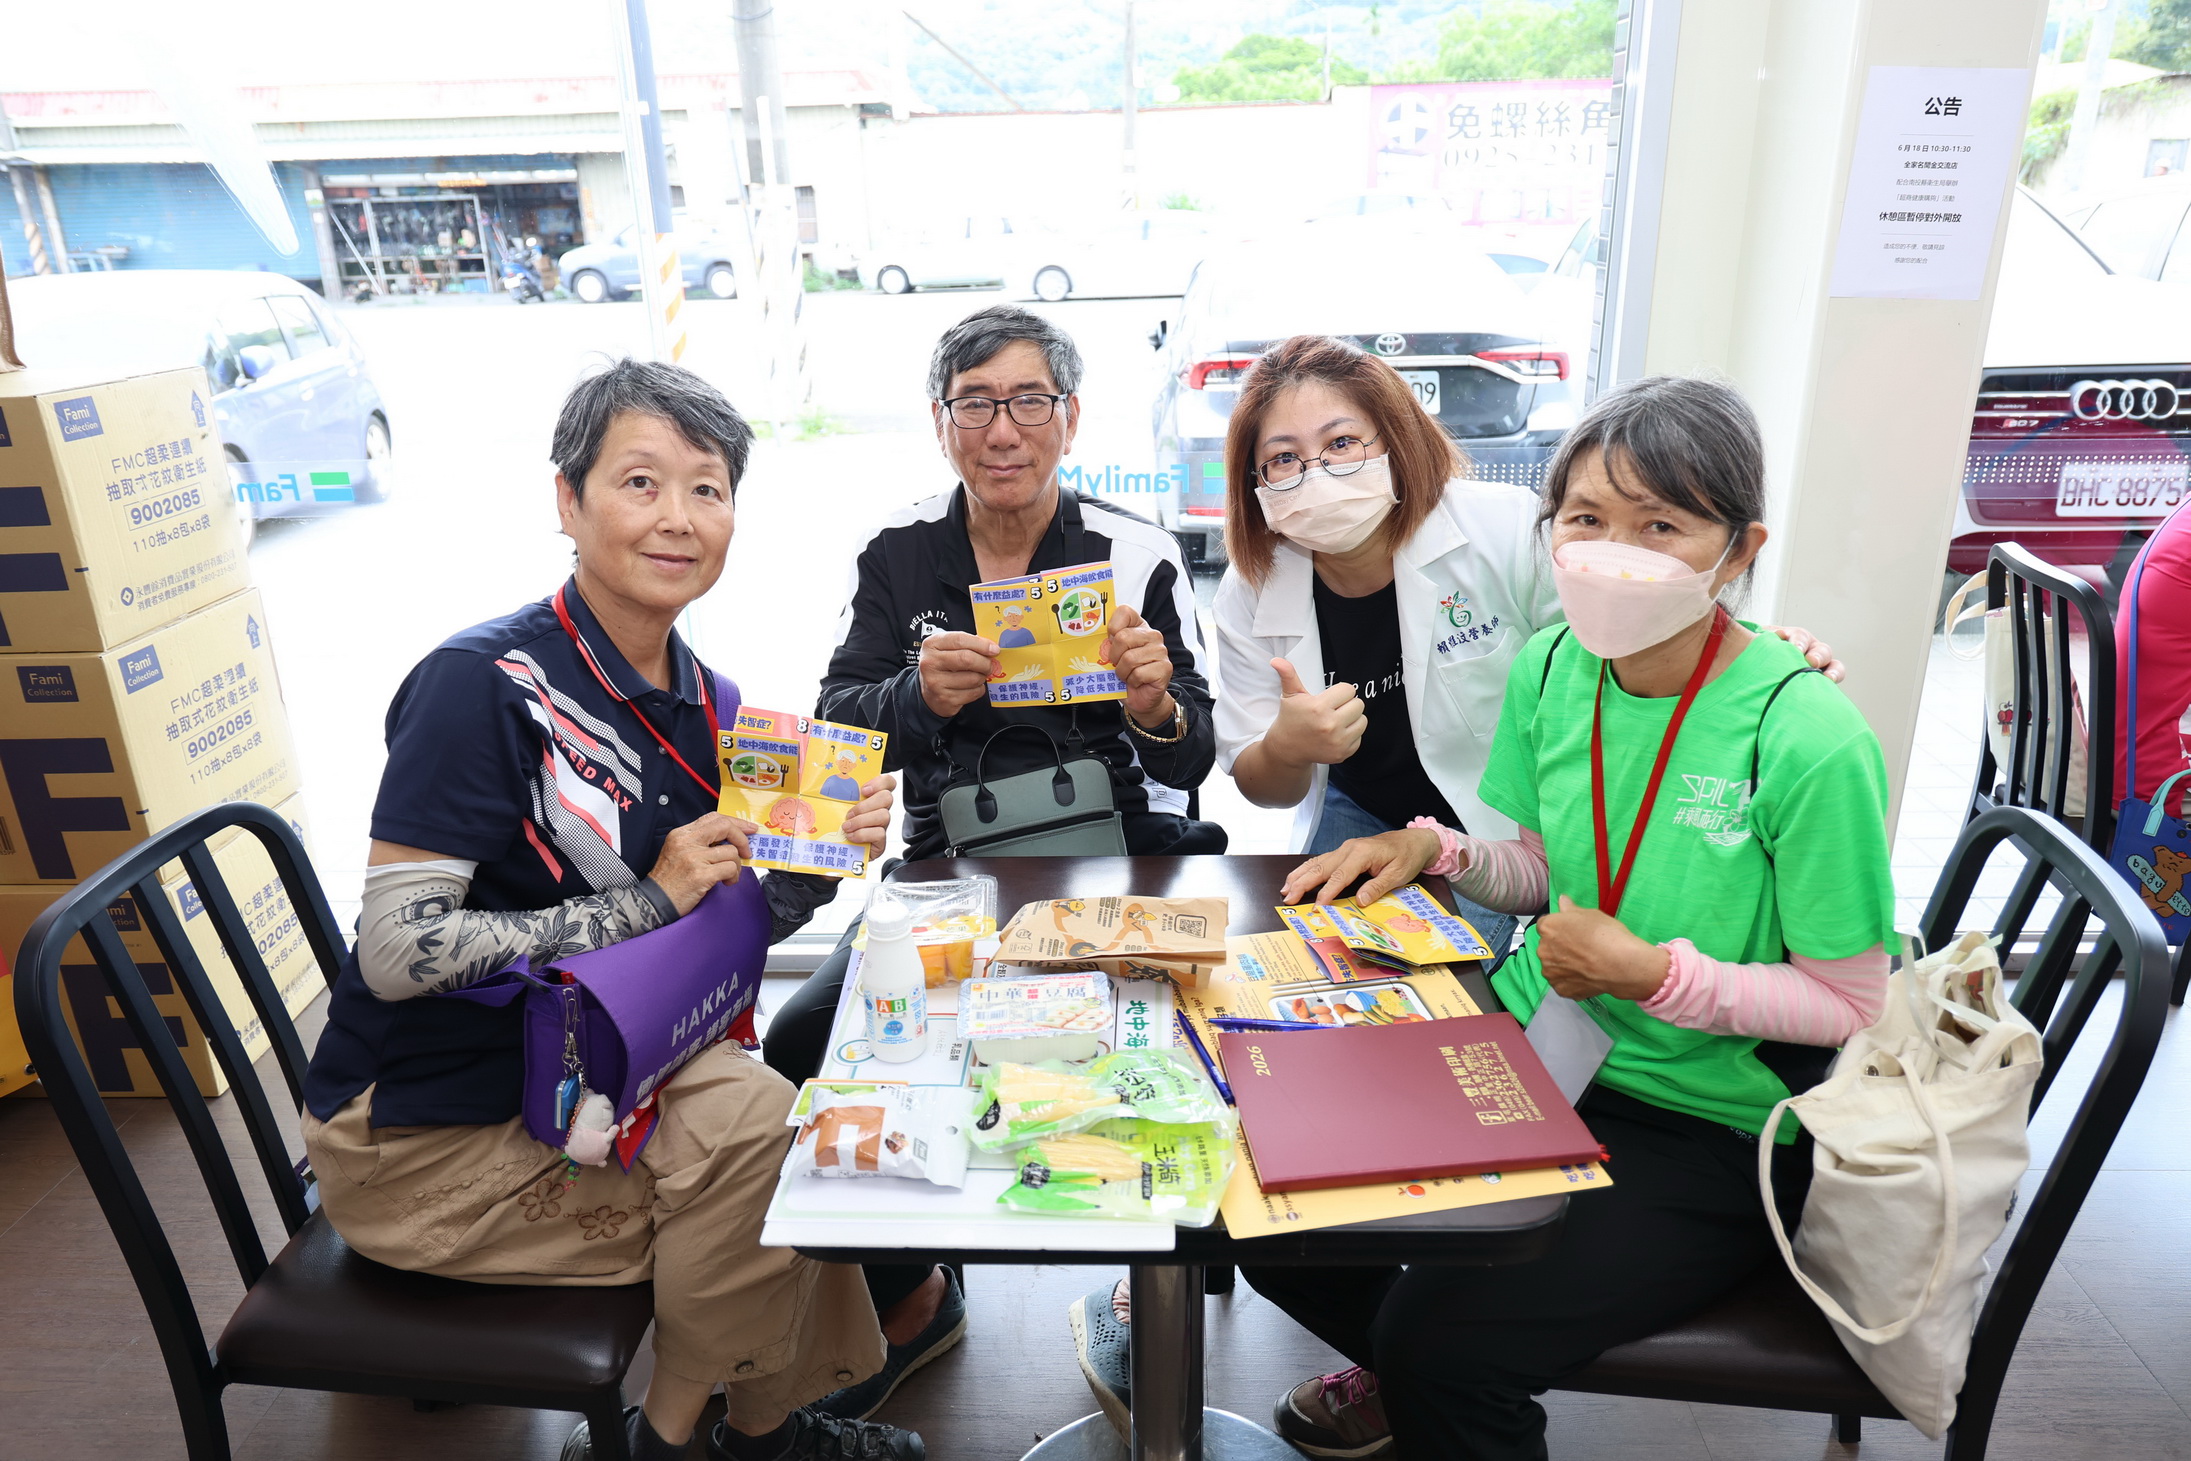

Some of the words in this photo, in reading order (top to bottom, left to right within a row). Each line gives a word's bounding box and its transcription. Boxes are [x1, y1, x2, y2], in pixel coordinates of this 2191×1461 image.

[1924, 97, 1962, 116] 公告
[1879, 212, 1962, 223] 休憩區暫停對外開放
[63, 404, 91, 422] Fami
[64, 422, 99, 435] Collection
[111, 437, 194, 474] FMC超柔連續
[105, 457, 207, 503] 抽取式花紋衛生紙
[129, 488, 201, 526] 9002085
[132, 513, 212, 553] 110抽x8包x8袋
[1030, 587, 1042, 599] 5
[1047, 580, 1058, 593] 5
[909, 610, 933, 631] BIELLA
[127, 656, 153, 675] Fami
[29, 673, 63, 685] Fami
[127, 668, 160, 687] Collection
[1065, 670, 1122, 686] 減少大腦發
[27, 687, 73, 698] Collection
[1045, 691, 1055, 702] 5
[1059, 689, 1071, 701] 5
[165, 676, 260, 742] 抽取式花紋衛生紙
[187, 709, 253, 758] 9002085
[796, 719, 809, 733] 8
[720, 736, 733, 749] 5
[871, 736, 884, 750] 5
[602, 776, 634, 812] MAX
[852, 862, 864, 876] 5
[1281, 908, 1296, 916] 5
[1349, 938, 1365, 947] 5
[1473, 947, 1489, 957] 5
[671, 971, 750, 1048] HAKKA
[877, 999, 906, 1013] AB
[1124, 1000, 1150, 1049] 地中海
[1246, 1045, 1272, 1077] 2026
